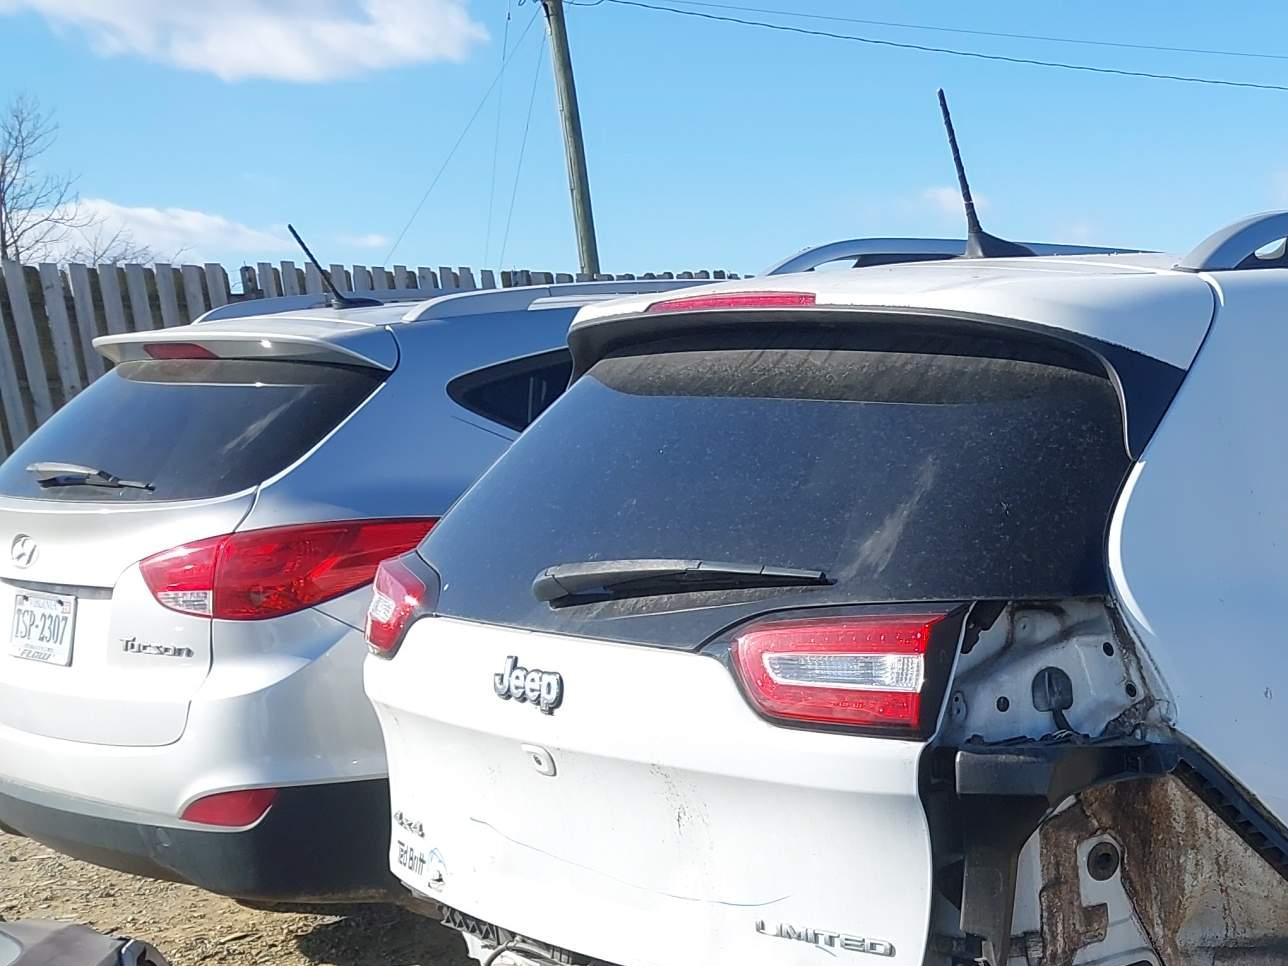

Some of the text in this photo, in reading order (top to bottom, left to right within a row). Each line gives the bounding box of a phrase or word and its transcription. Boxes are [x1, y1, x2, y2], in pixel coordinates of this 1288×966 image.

[120, 637, 194, 657] Tucson
[494, 656, 564, 716] Jeep
[755, 920, 896, 957] LIMITED
